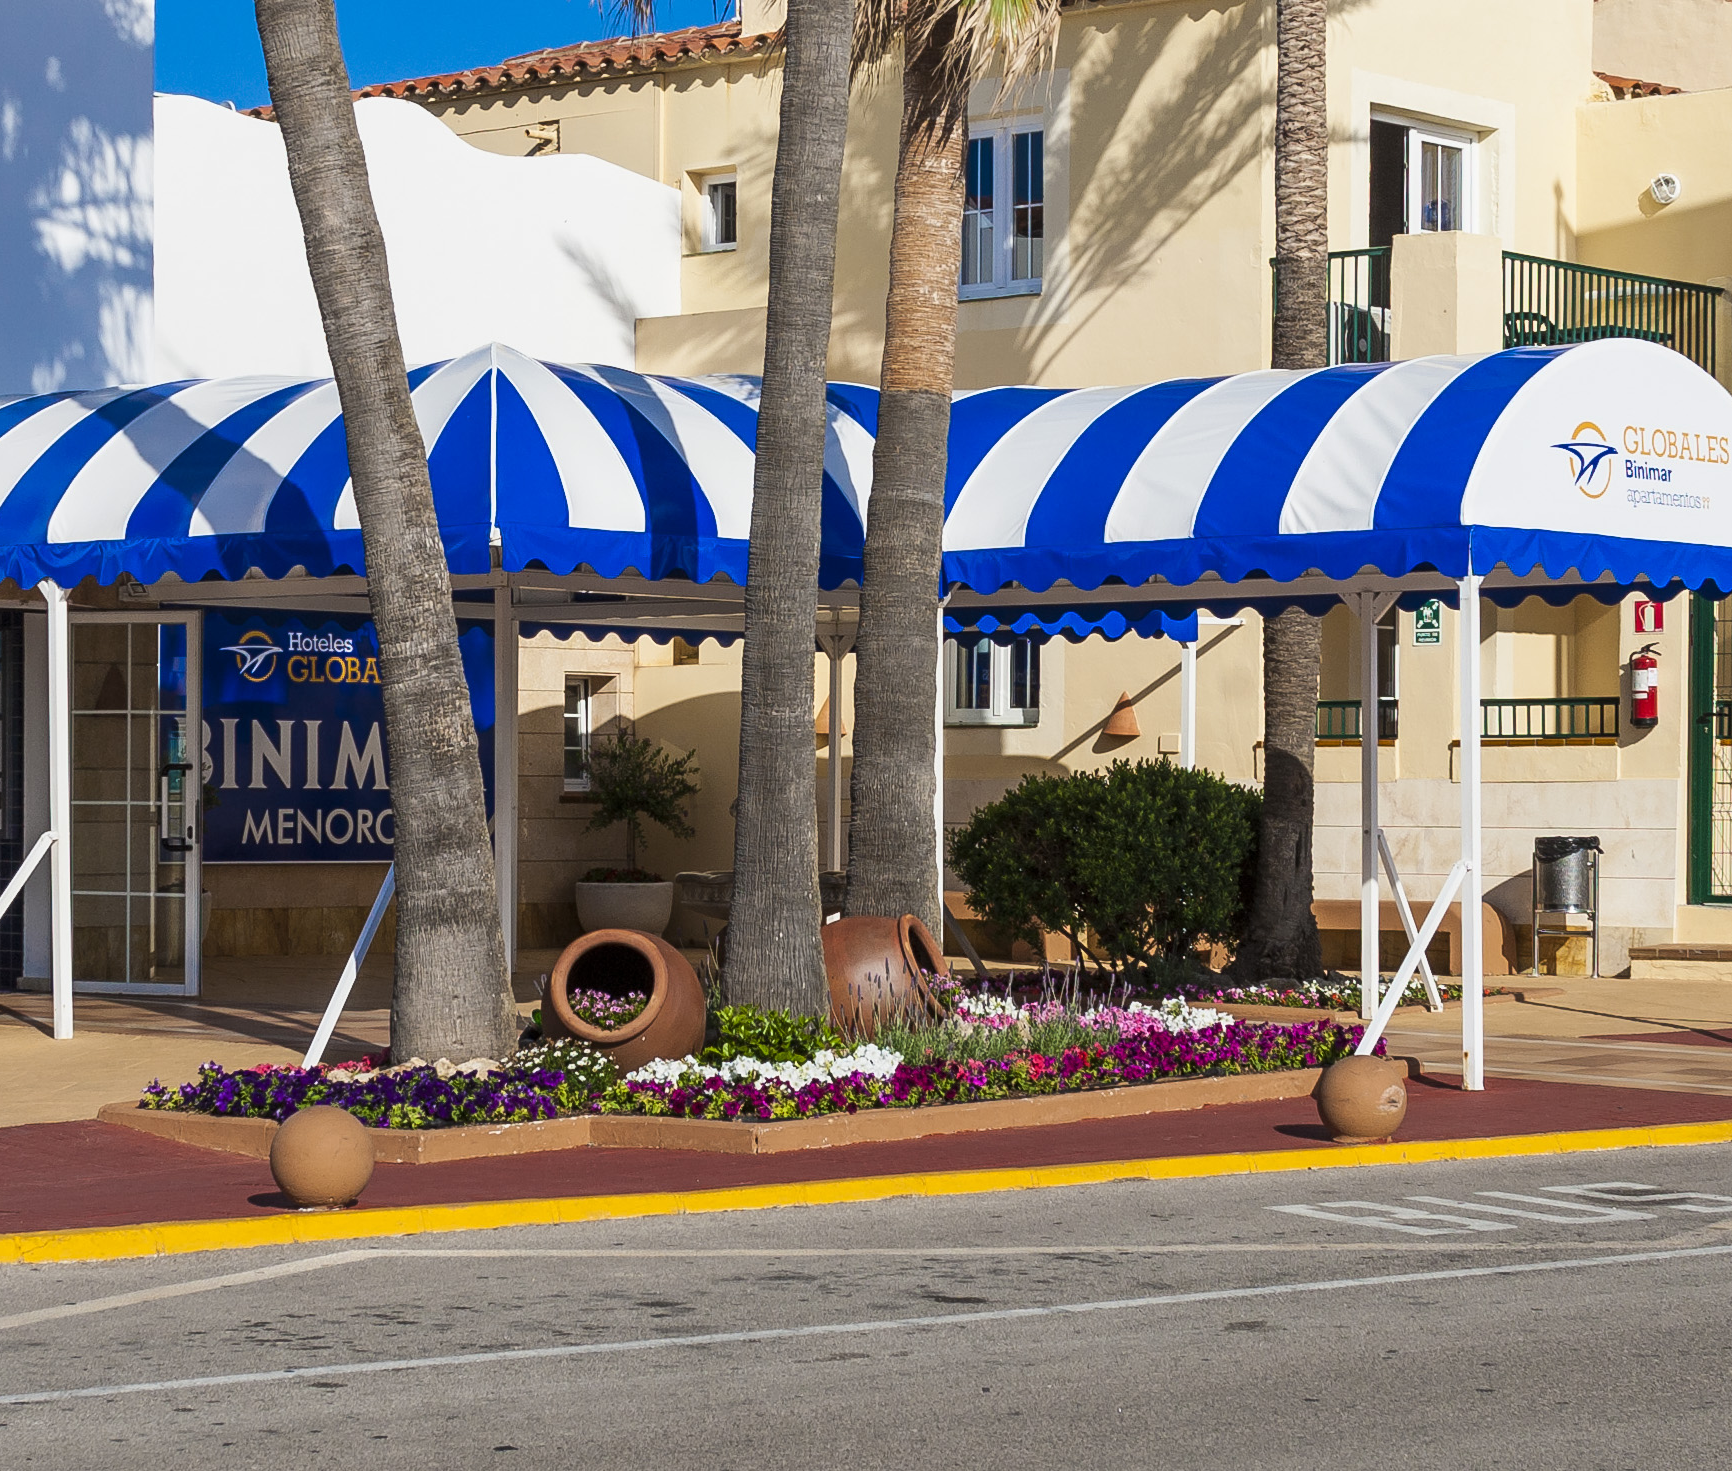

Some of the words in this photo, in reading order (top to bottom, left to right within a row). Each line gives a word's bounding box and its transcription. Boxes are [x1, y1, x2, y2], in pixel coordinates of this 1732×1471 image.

[1623, 425, 1730, 465] GLOBALES
[1625, 459, 1673, 482] Binimar
[1626, 488, 1702, 509] apartamentos
[287, 631, 354, 653] Hoteles
[287, 655, 382, 684] GLOBA
[174, 716, 390, 790] BINIM
[241, 808, 395, 845] MENORC
